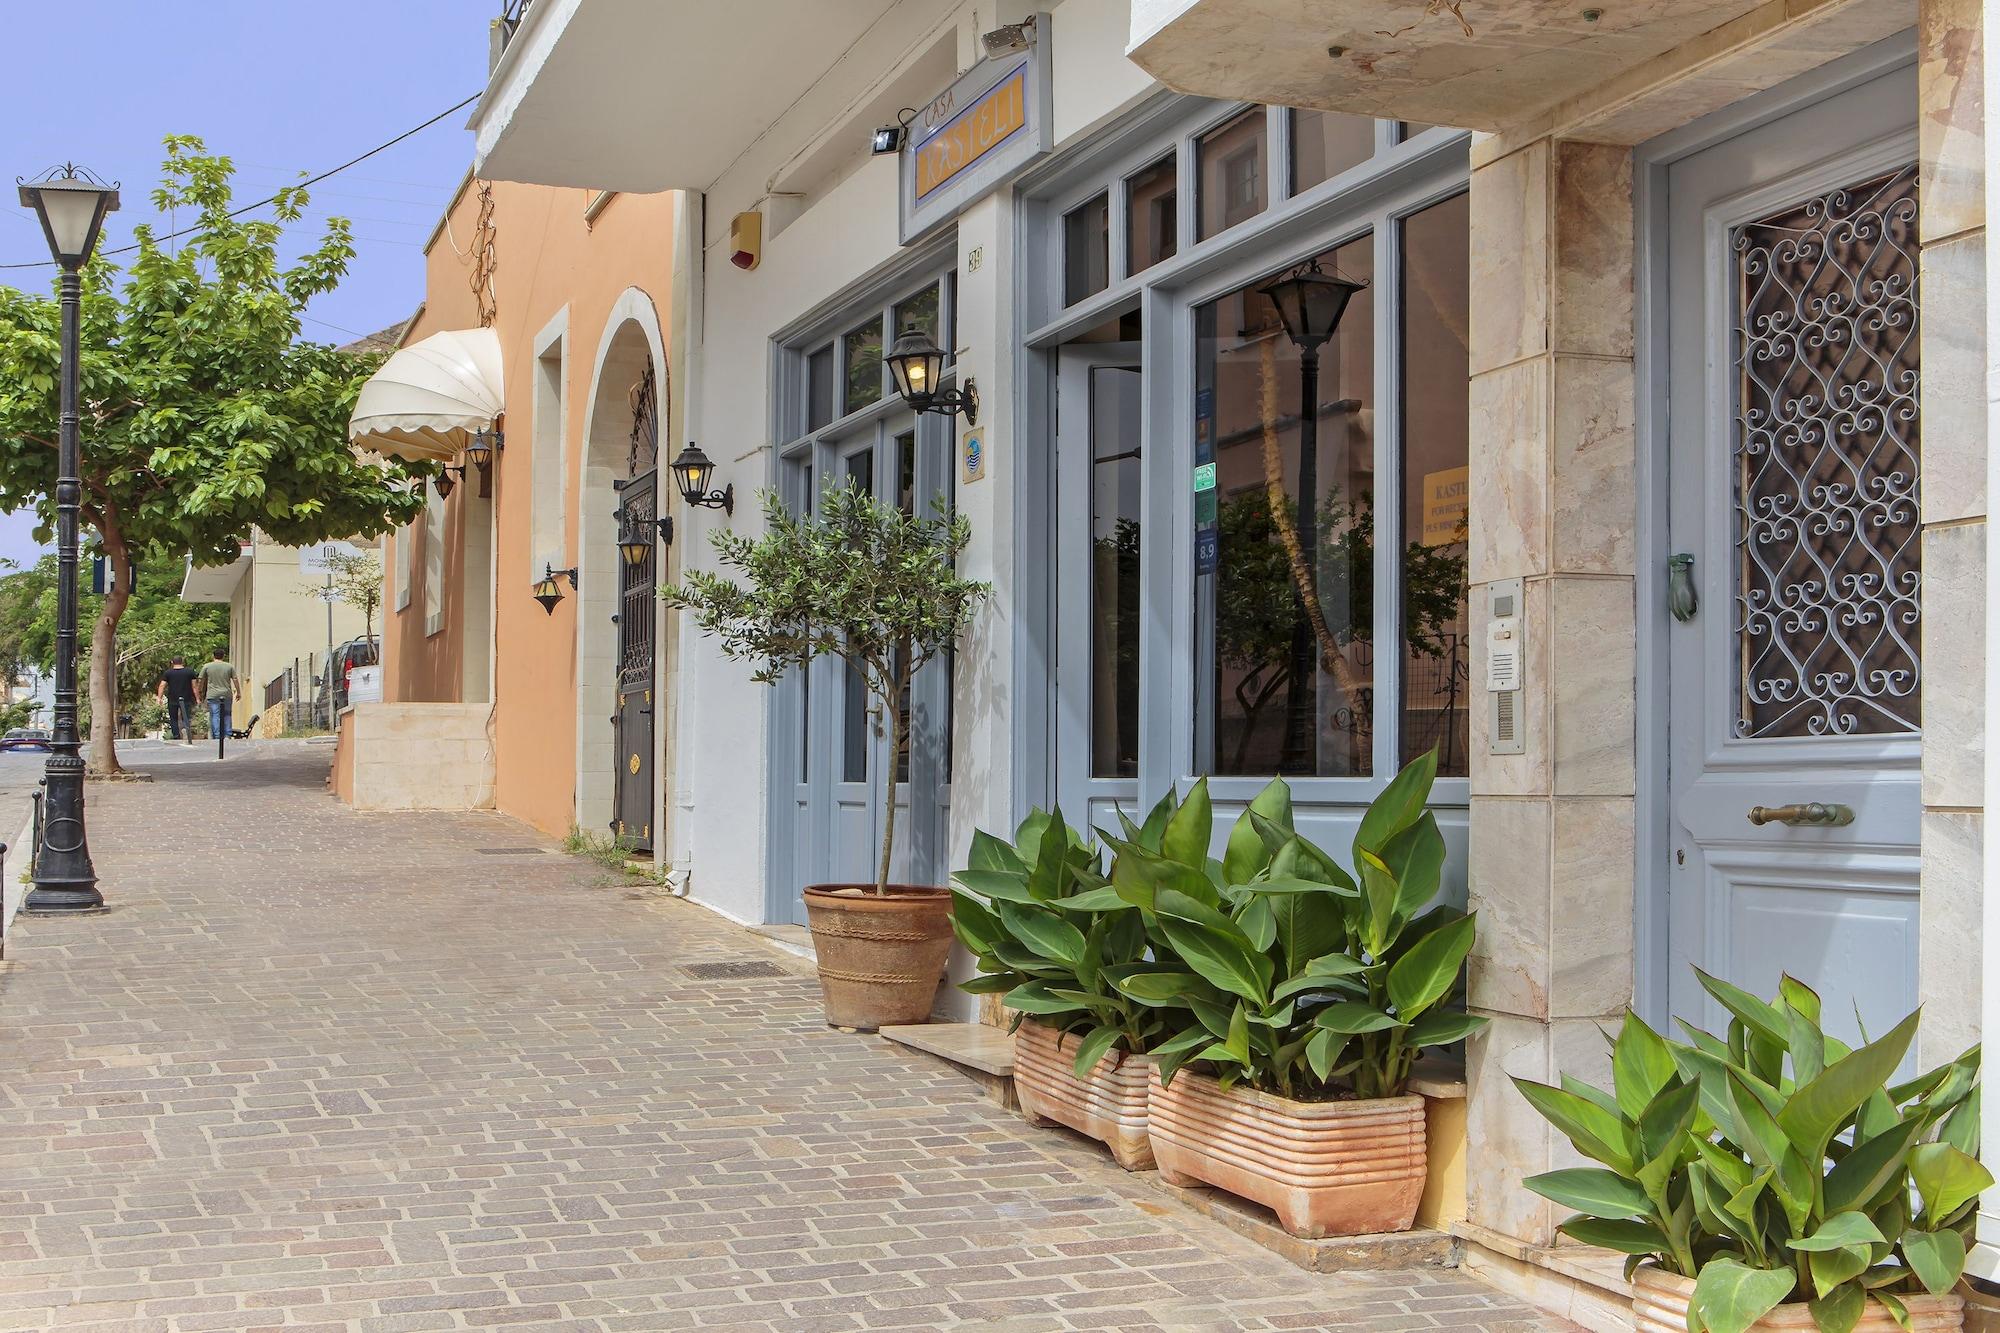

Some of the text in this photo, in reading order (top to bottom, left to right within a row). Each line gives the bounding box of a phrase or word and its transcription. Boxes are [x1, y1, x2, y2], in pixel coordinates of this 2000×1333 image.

[925, 90, 955, 128] CASA
[926, 82, 1016, 185] KASTELI
[969, 246, 983, 273] 39
